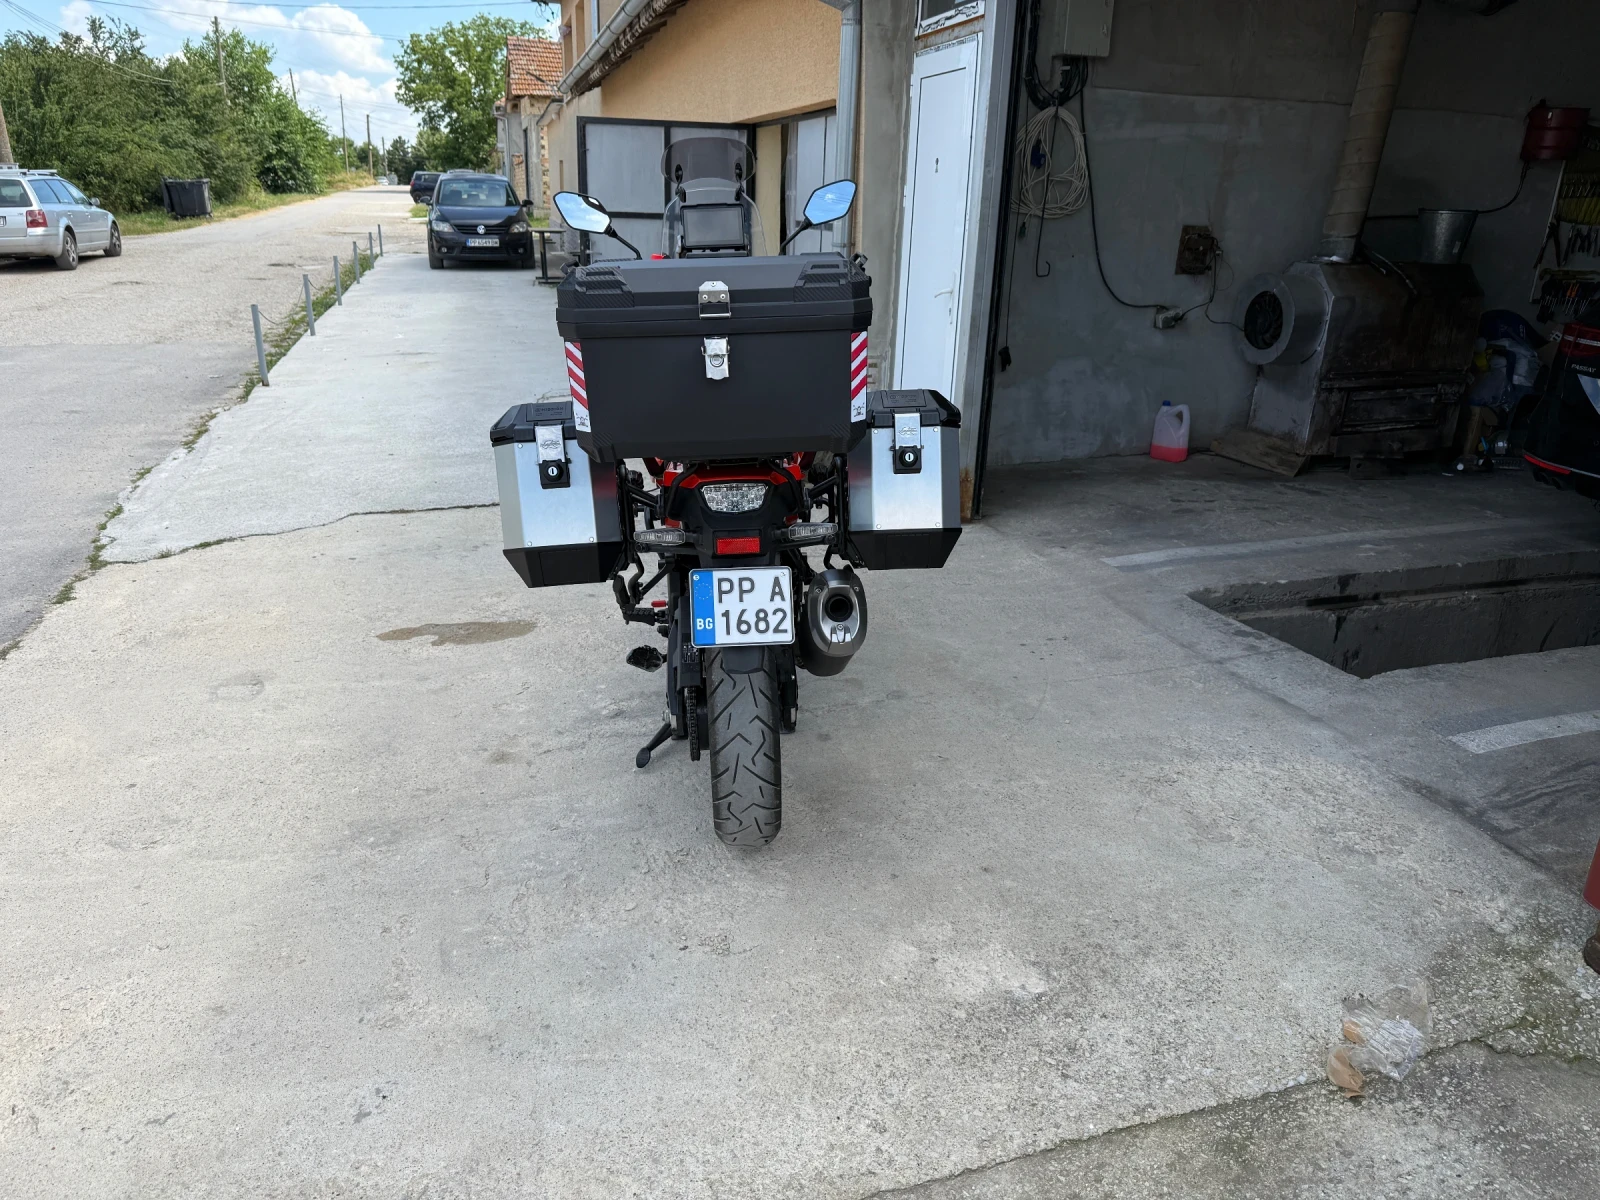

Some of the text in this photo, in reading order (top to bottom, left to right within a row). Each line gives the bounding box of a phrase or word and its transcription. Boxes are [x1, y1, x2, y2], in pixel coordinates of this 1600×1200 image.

[1571, 363, 1597, 374] PASSAT
[717, 576, 786, 603] PP A
[696, 618, 714, 630] BG
[721, 607, 788, 636] 1682
